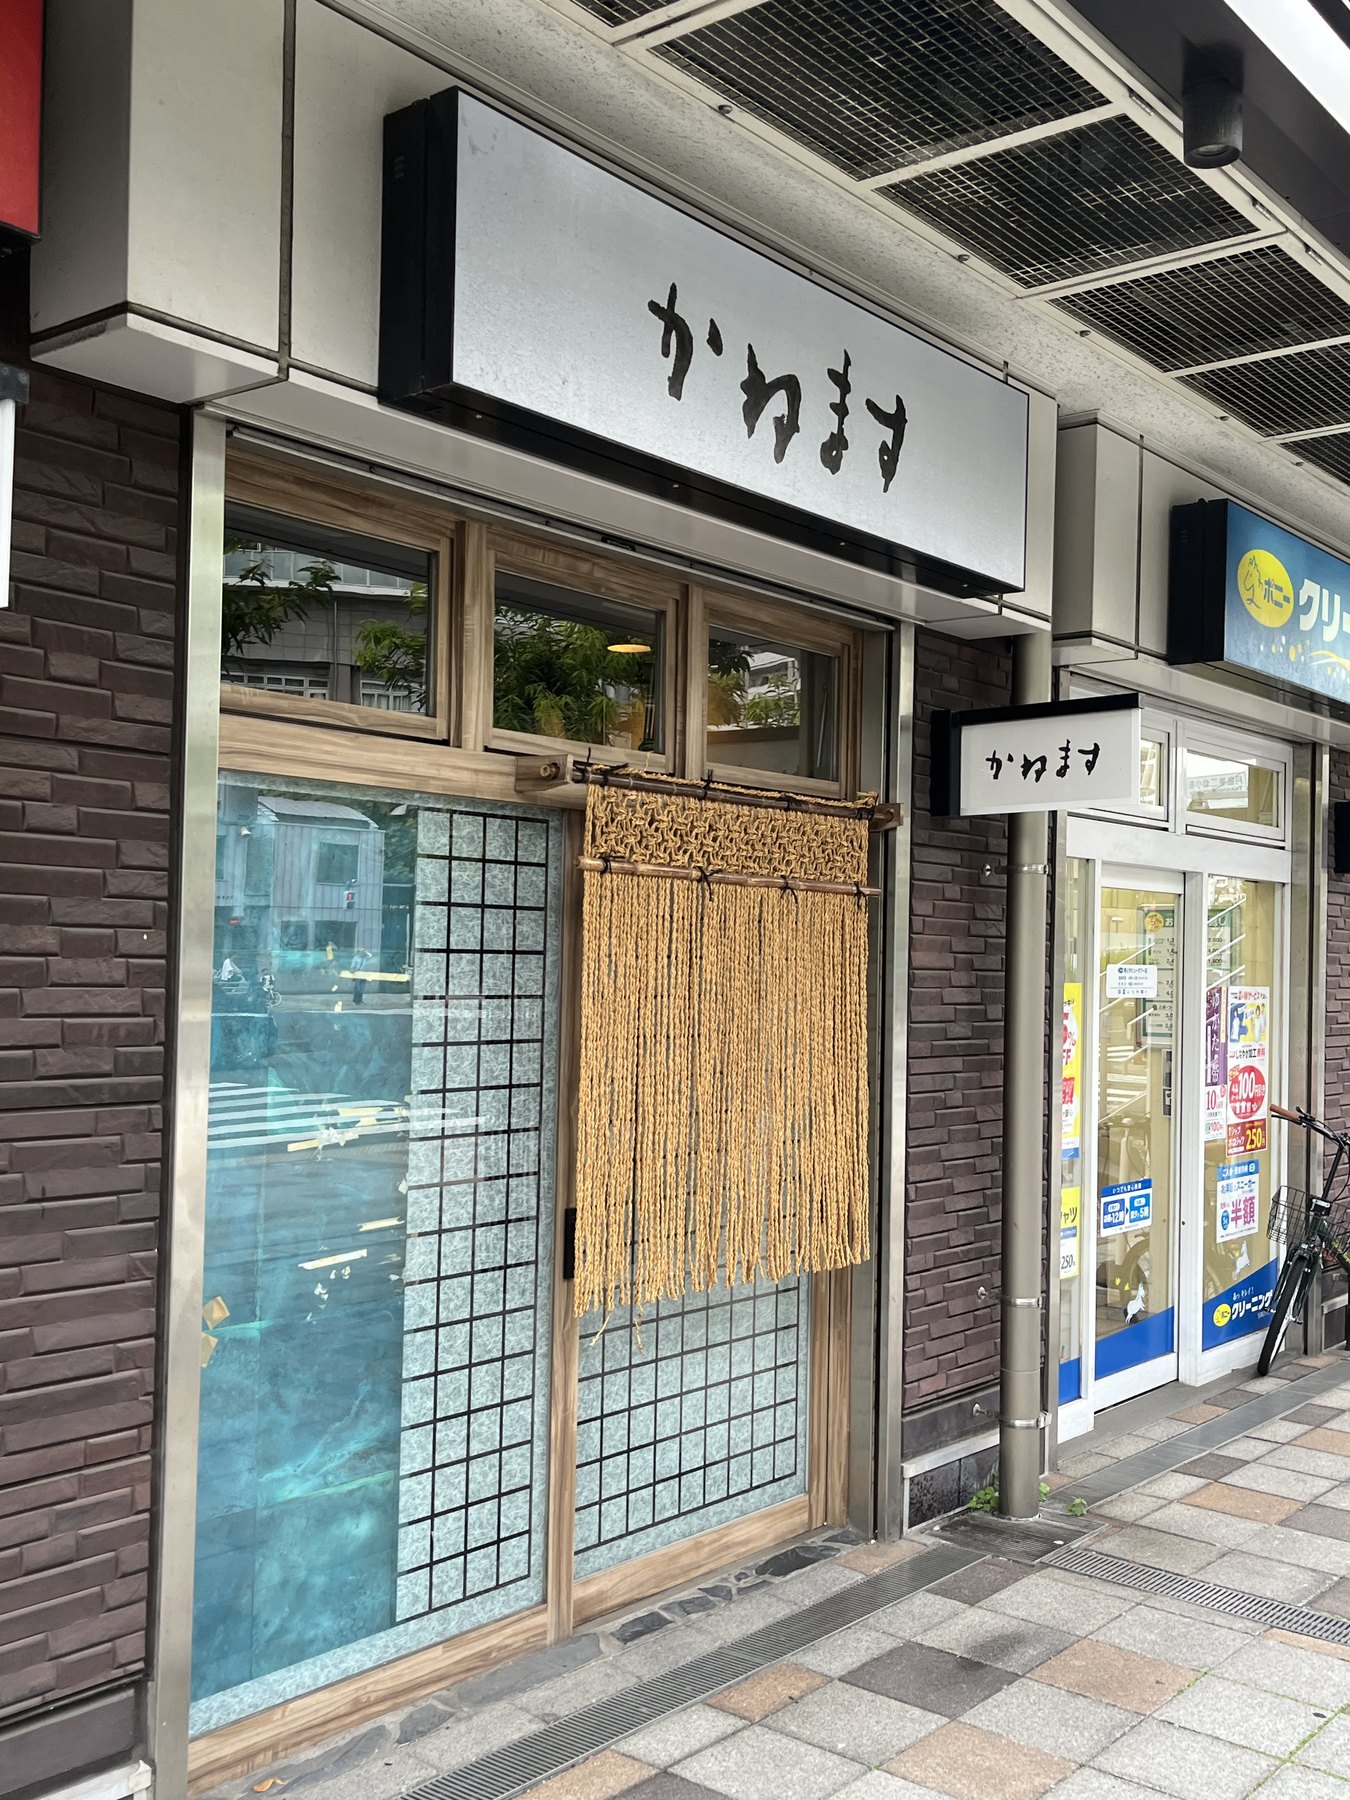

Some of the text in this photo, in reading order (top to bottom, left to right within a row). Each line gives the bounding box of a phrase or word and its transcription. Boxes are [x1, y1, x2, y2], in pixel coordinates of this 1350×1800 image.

[647, 281, 908, 493] かねます
[1263, 577, 1291, 609] ポニー
[985, 739, 1101, 783] かねます
[1231, 1196, 1256, 1228] 半額
[1231, 1289, 1273, 1321] クリーニング
